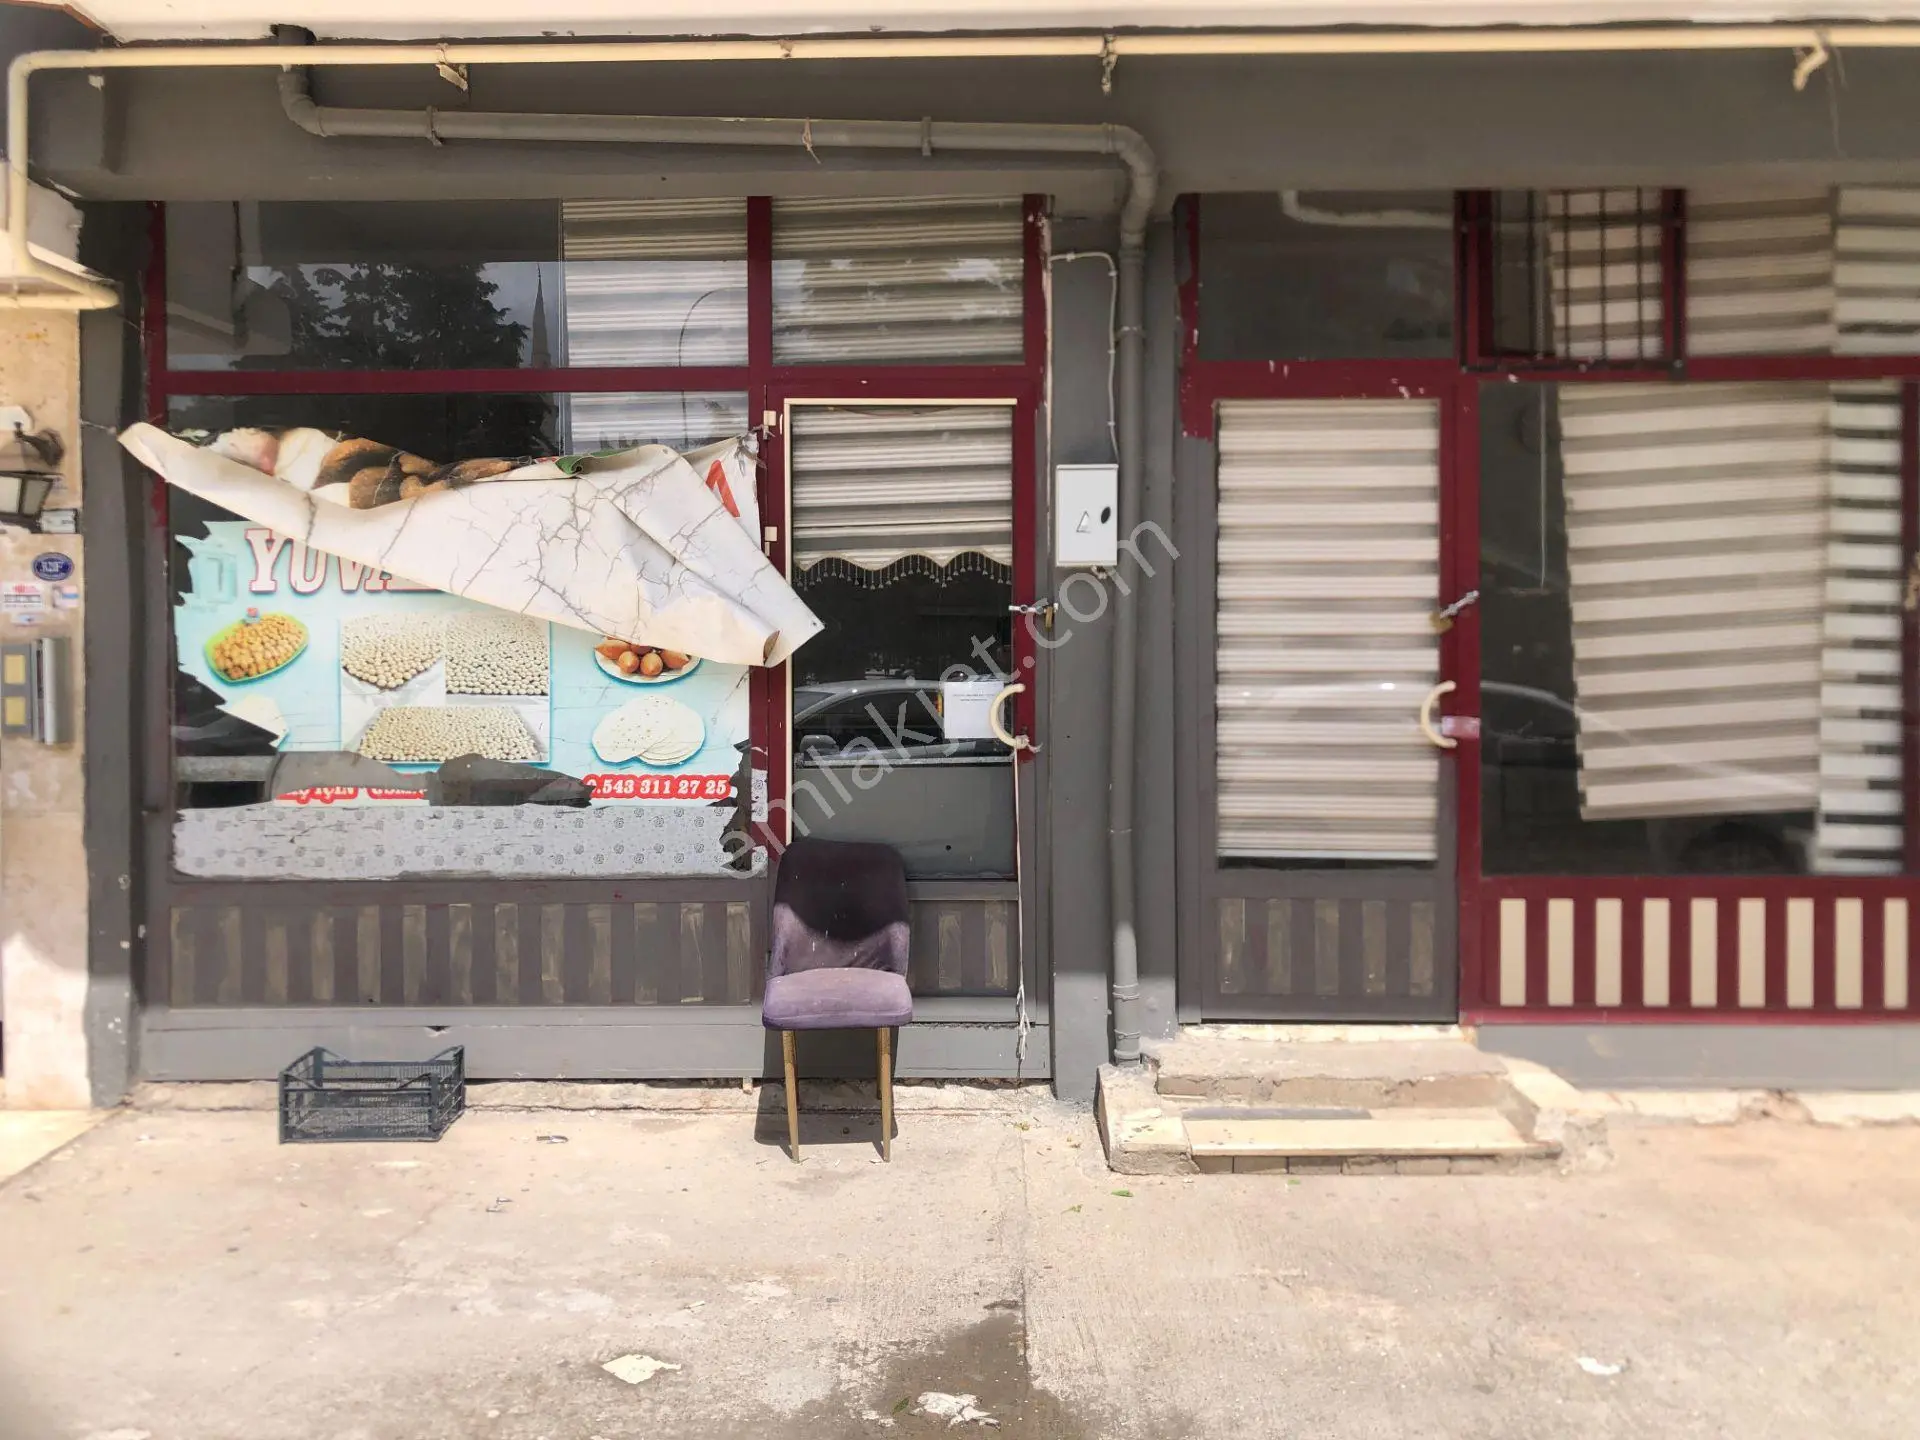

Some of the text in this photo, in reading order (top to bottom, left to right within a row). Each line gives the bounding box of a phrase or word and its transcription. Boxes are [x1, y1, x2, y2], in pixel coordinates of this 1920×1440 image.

[639, 779, 671, 794] 311
[678, 780, 700, 794] 27
[705, 780, 727, 794] 25
